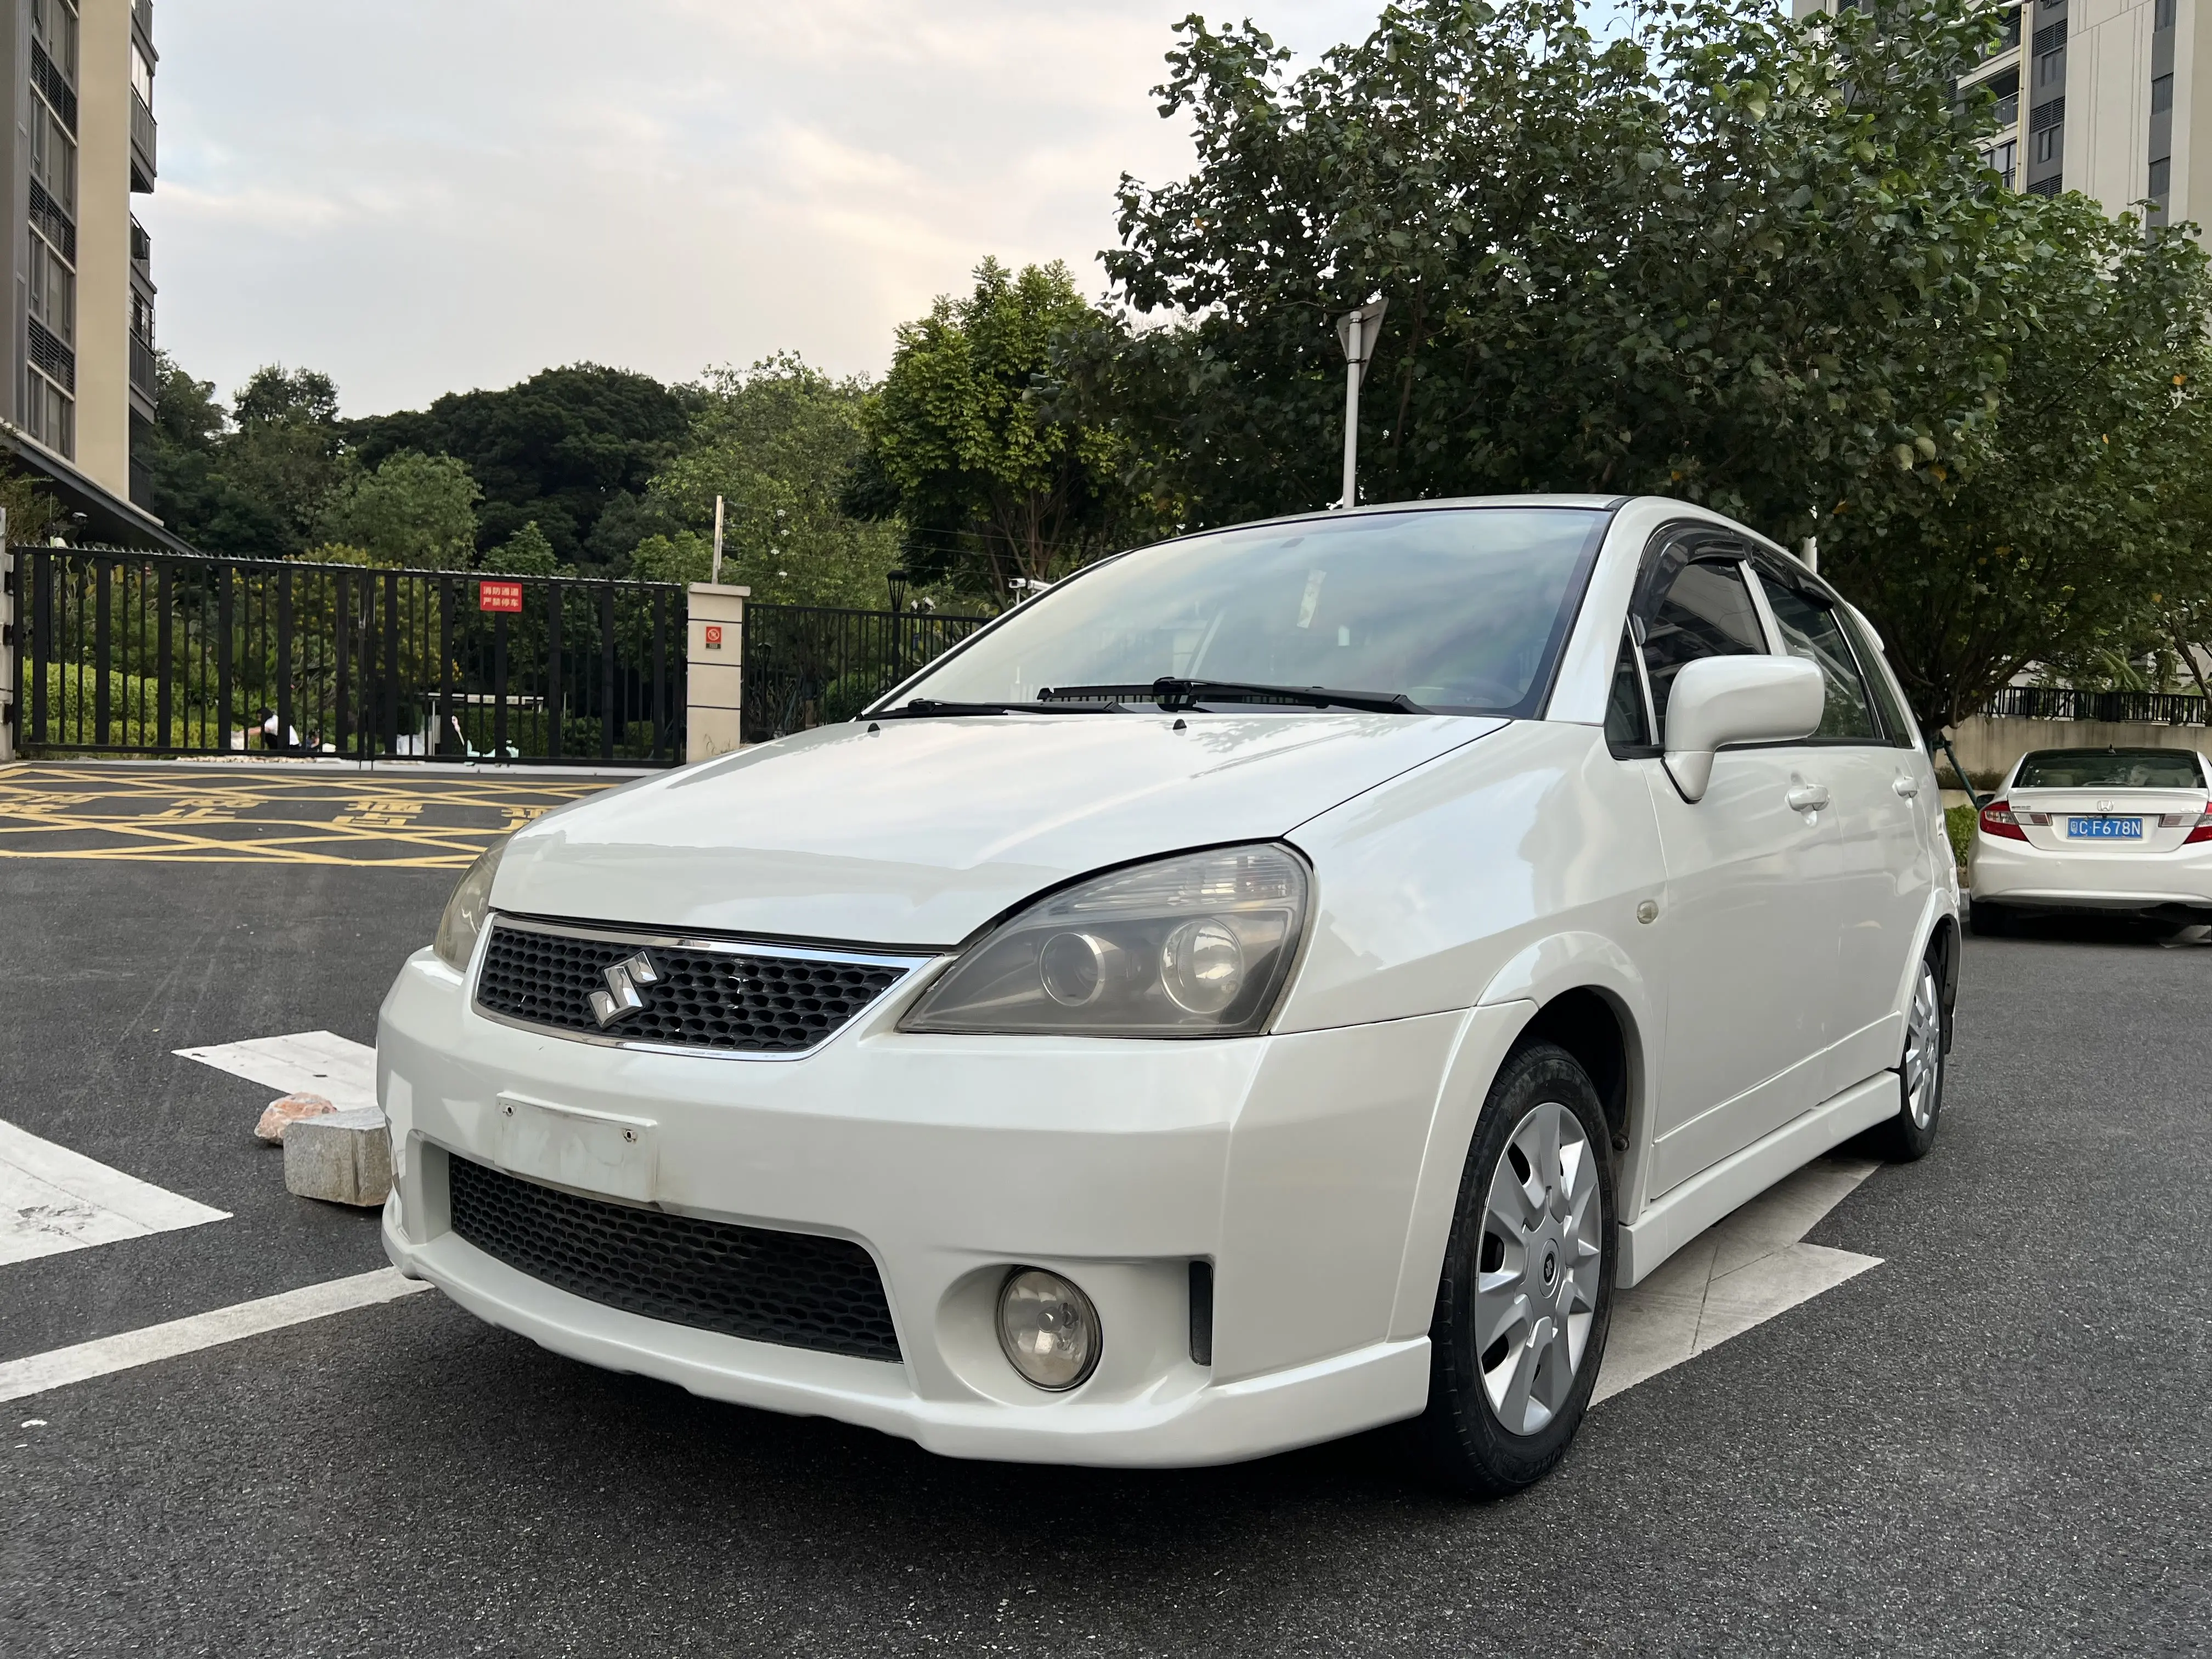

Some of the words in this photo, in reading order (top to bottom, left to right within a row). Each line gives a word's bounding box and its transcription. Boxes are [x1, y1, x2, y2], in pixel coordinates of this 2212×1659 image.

[483, 586, 518, 596] 消防通道
[483, 597, 518, 607] 严禁停车
